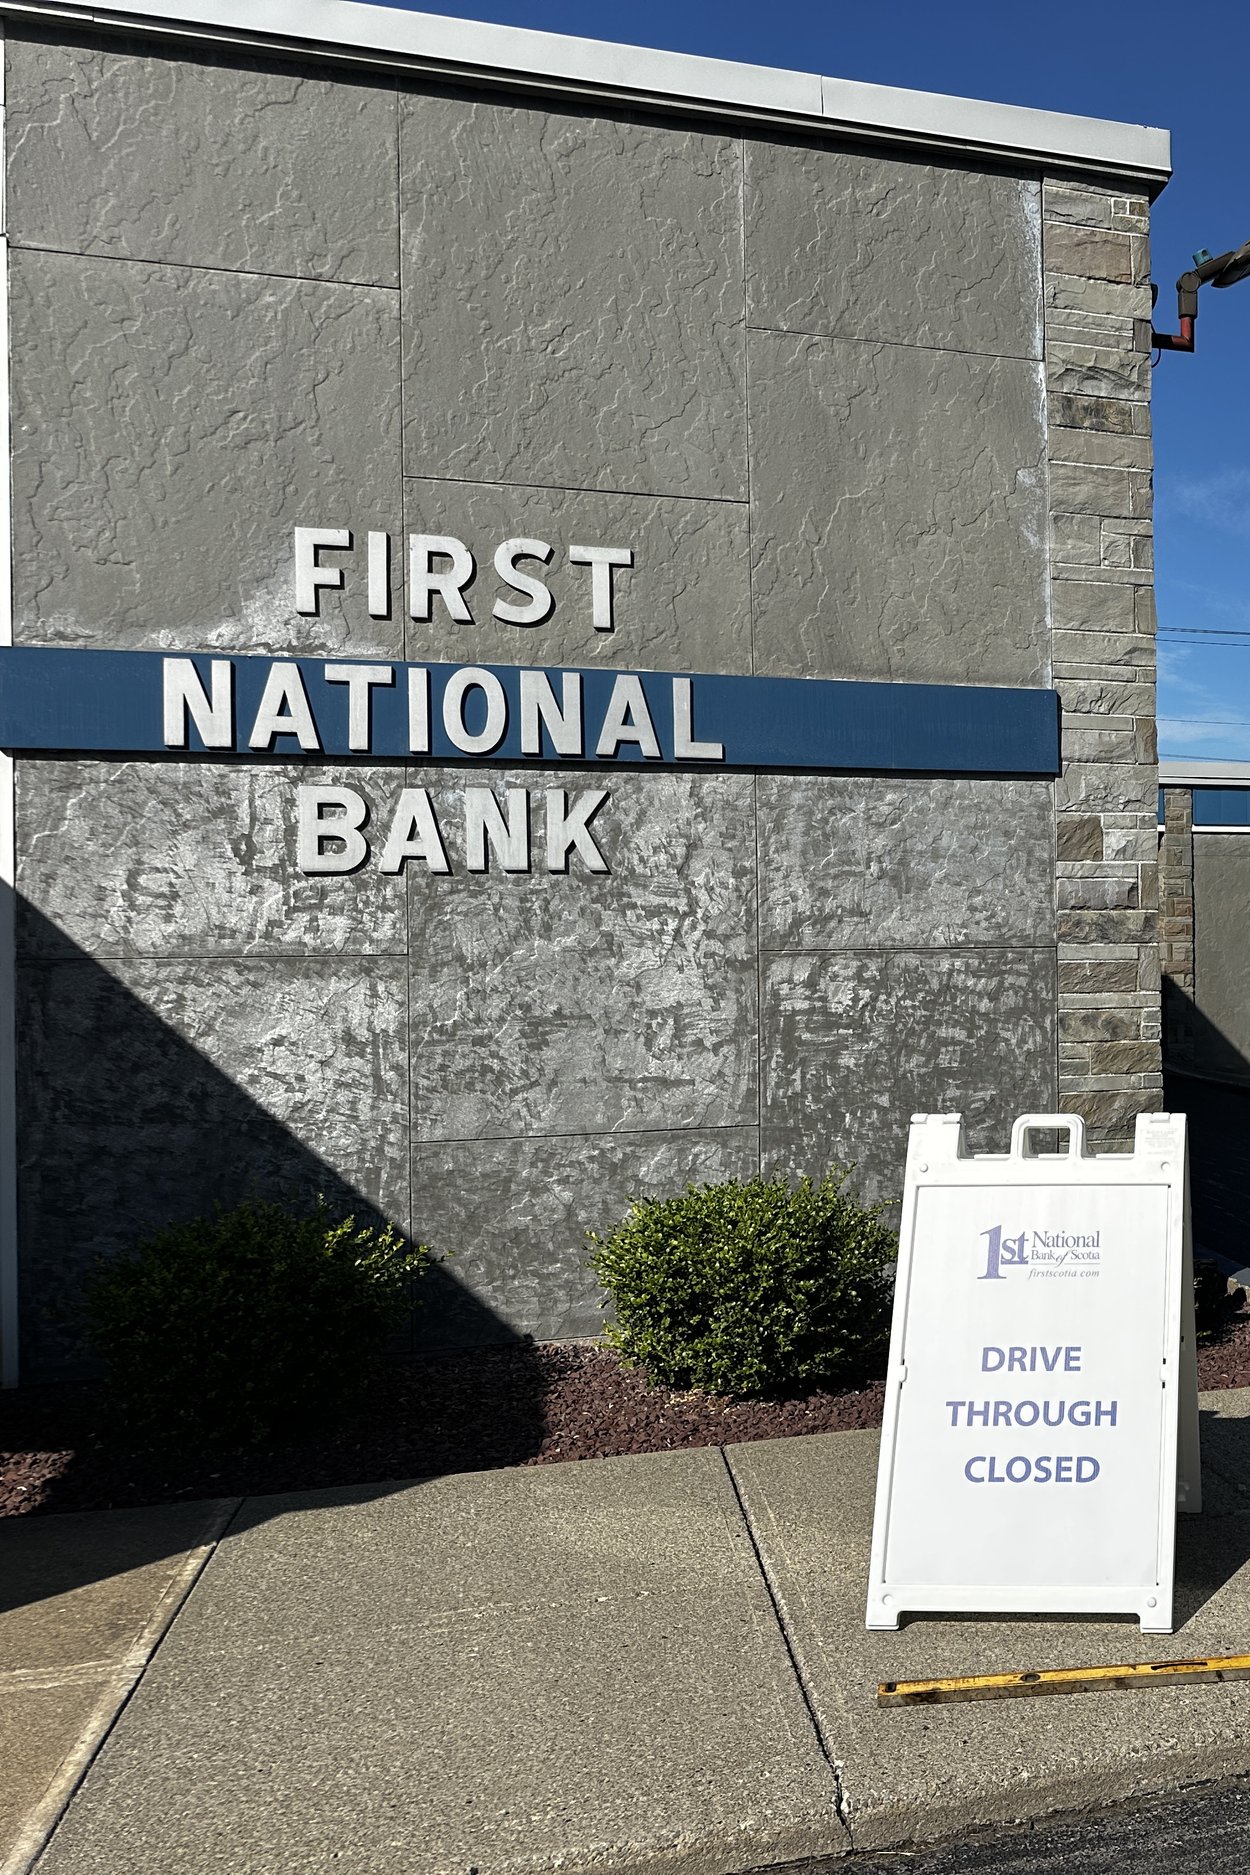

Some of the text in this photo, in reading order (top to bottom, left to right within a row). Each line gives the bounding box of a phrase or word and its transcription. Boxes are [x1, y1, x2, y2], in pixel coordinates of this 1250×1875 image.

[294, 527, 633, 633] FIRST
[162, 657, 725, 761] NATIONAL
[300, 785, 612, 875] BANK
[977, 1225, 1029, 1279] 1st
[1032, 1230, 1100, 1248] National
[1031, 1250, 1100, 1268] Bank of Scotia
[981, 1346, 1082, 1372] DRIVE
[945, 1400, 1118, 1427] THROUGH
[964, 1456, 1101, 1483] CLOSED
